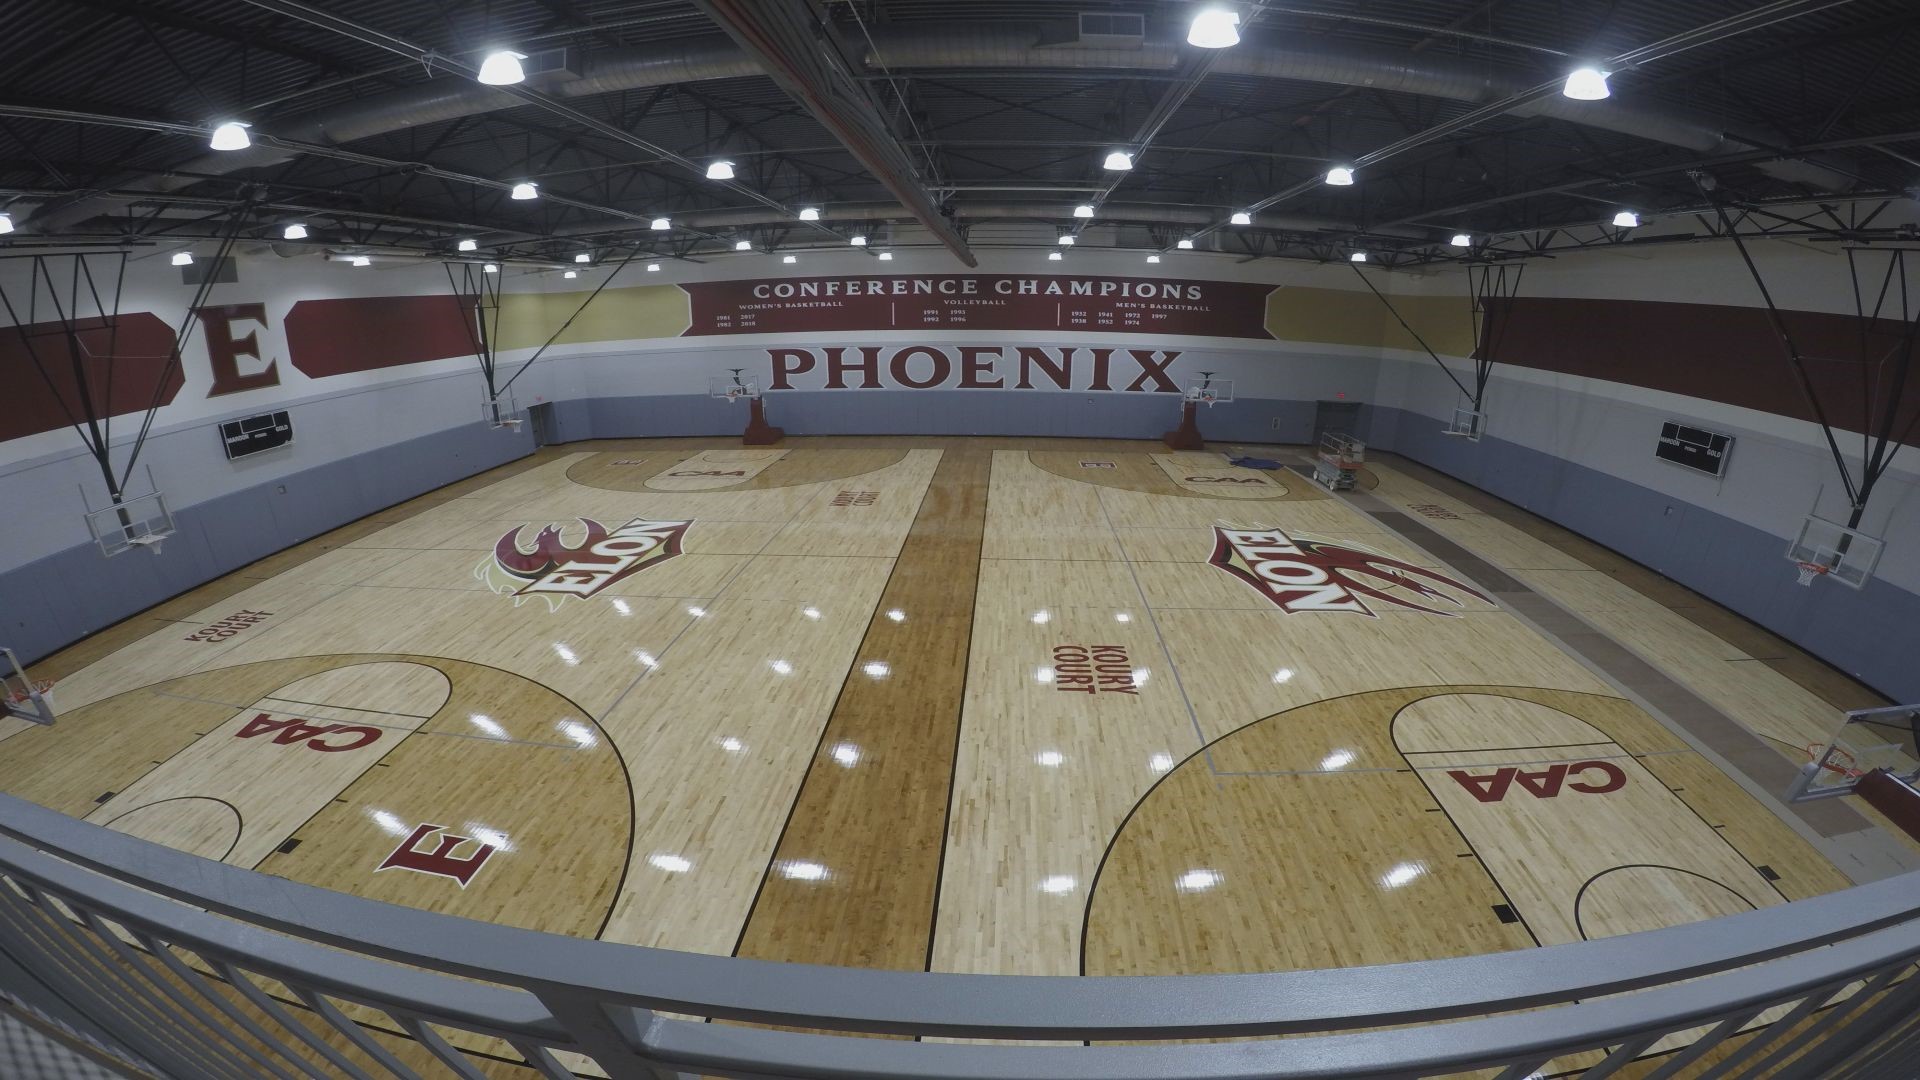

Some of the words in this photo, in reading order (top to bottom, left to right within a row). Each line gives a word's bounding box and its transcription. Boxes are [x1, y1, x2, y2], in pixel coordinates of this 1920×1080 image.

[753, 279, 978, 299] CONFERENCE
[995, 279, 1202, 300] CHAMPIONS
[1150, 304, 1210, 312] BASKETBALL
[188, 302, 281, 399] E
[766, 346, 1183, 393] PHOENIX
[1707, 448, 1722, 458] GOLD
[1184, 476, 1268, 485] CAA
[522, 518, 690, 596] ELON
[1219, 527, 1370, 612] ELON
[183, 609, 256, 642] KOURY
[206, 610, 274, 643] COURT
[1053, 645, 1096, 695] COURT
[1091, 645, 1140, 695] KOURY
[235, 713, 383, 753] CAA
[1446, 760, 1627, 803] CAA
[373, 822, 509, 891] E
